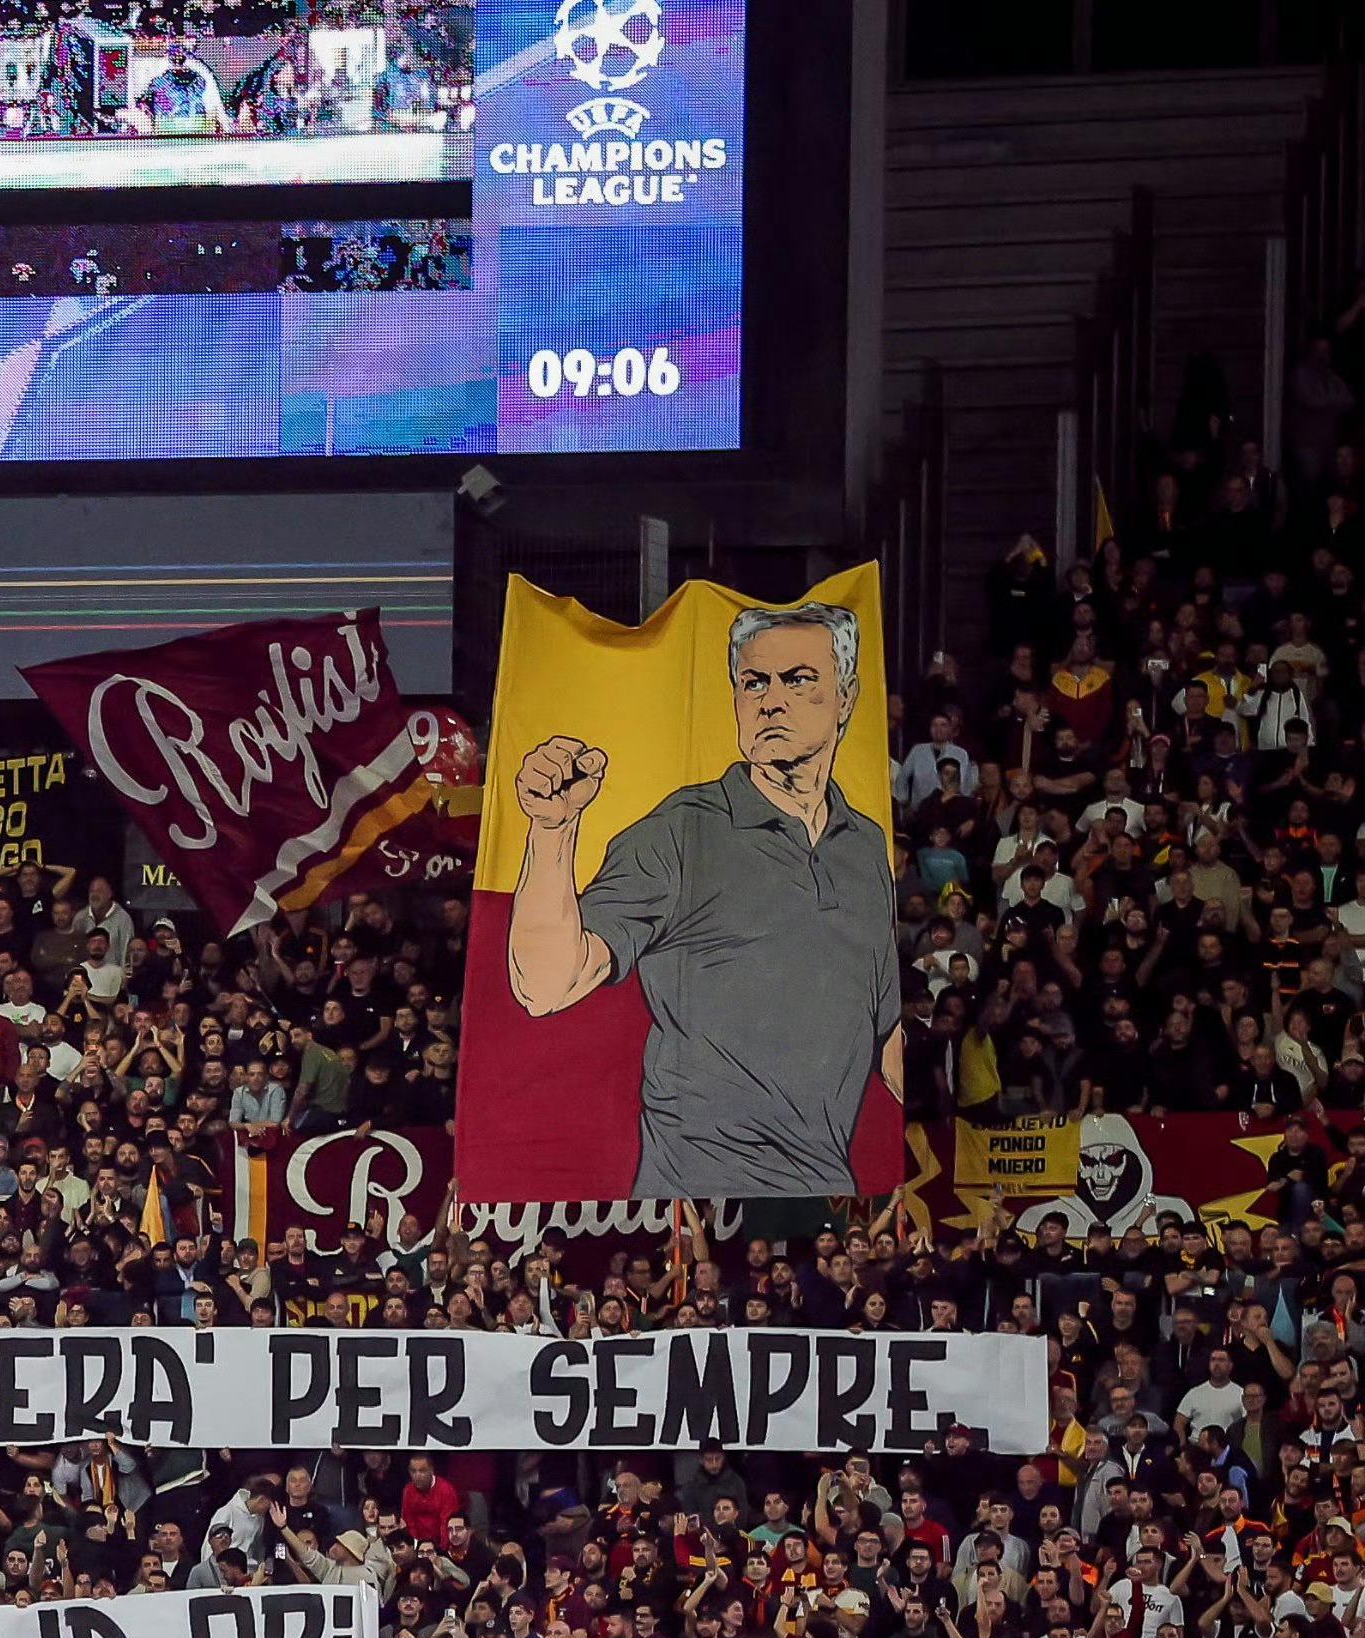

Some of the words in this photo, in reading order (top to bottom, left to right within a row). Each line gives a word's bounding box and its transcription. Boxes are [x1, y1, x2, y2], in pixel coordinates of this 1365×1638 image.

[489, 138, 727, 174] CHAMPIONS
[533, 174, 685, 206] LEAGUE
[528, 346, 680, 398] 09:06
[989, 1136, 1046, 1152] PONGO
[988, 1157, 1046, 1175] MUERO
[269, 1334, 473, 1448] PER
